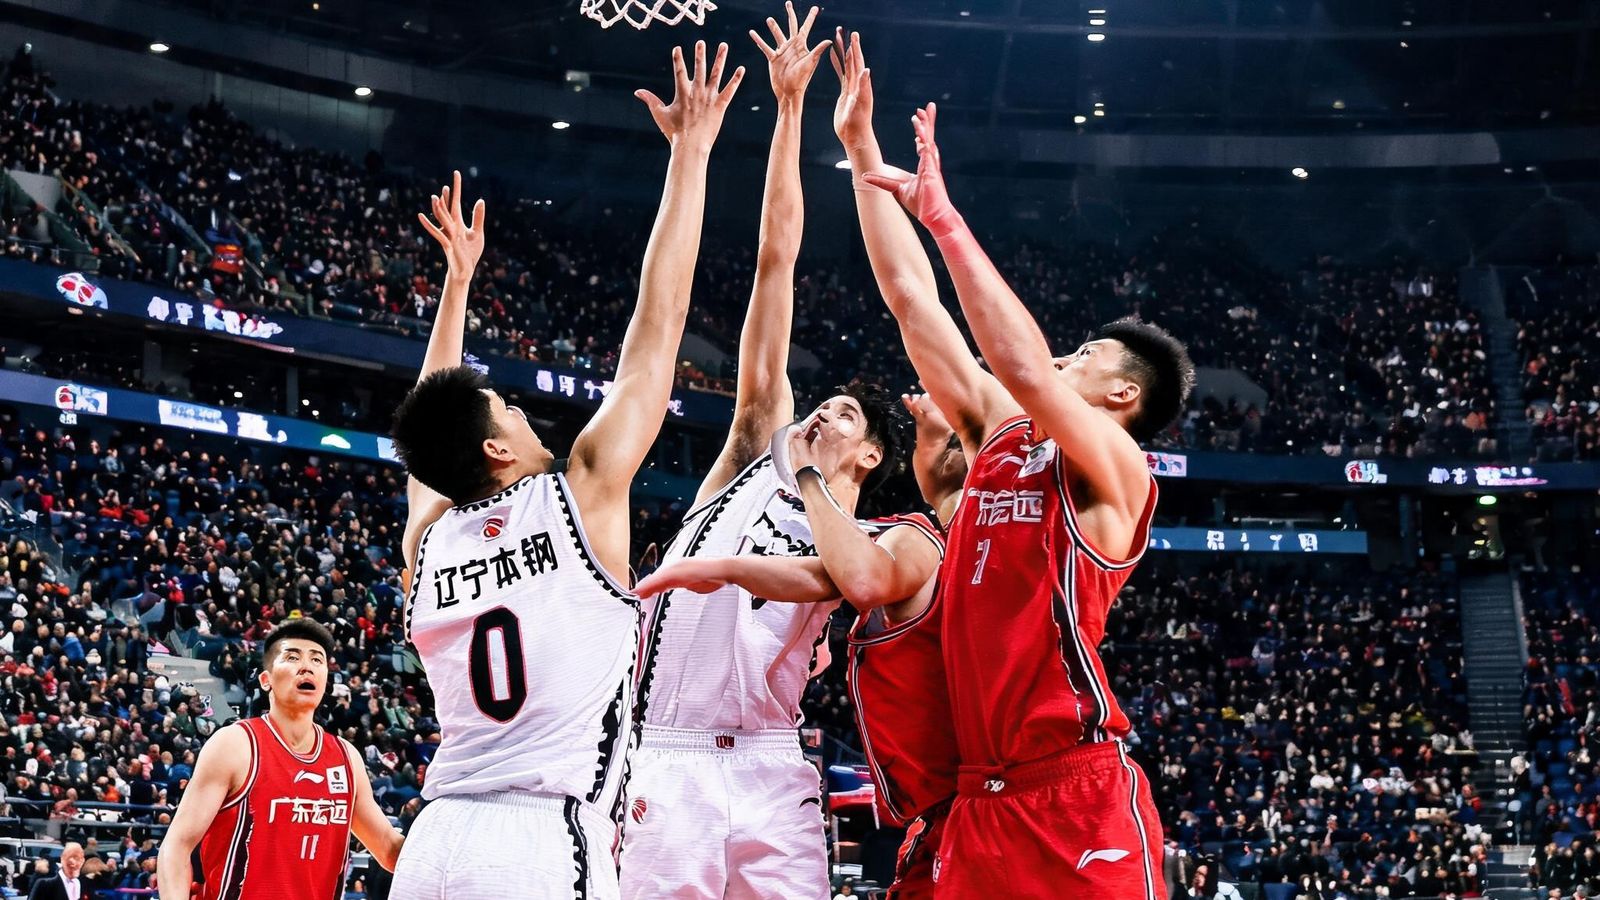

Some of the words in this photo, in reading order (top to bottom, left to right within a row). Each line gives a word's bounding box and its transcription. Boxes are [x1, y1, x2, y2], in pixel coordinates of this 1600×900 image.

[434, 531, 559, 610] 辽宁本钢
[467, 605, 529, 724] 0
[300, 834, 320, 860] 11
